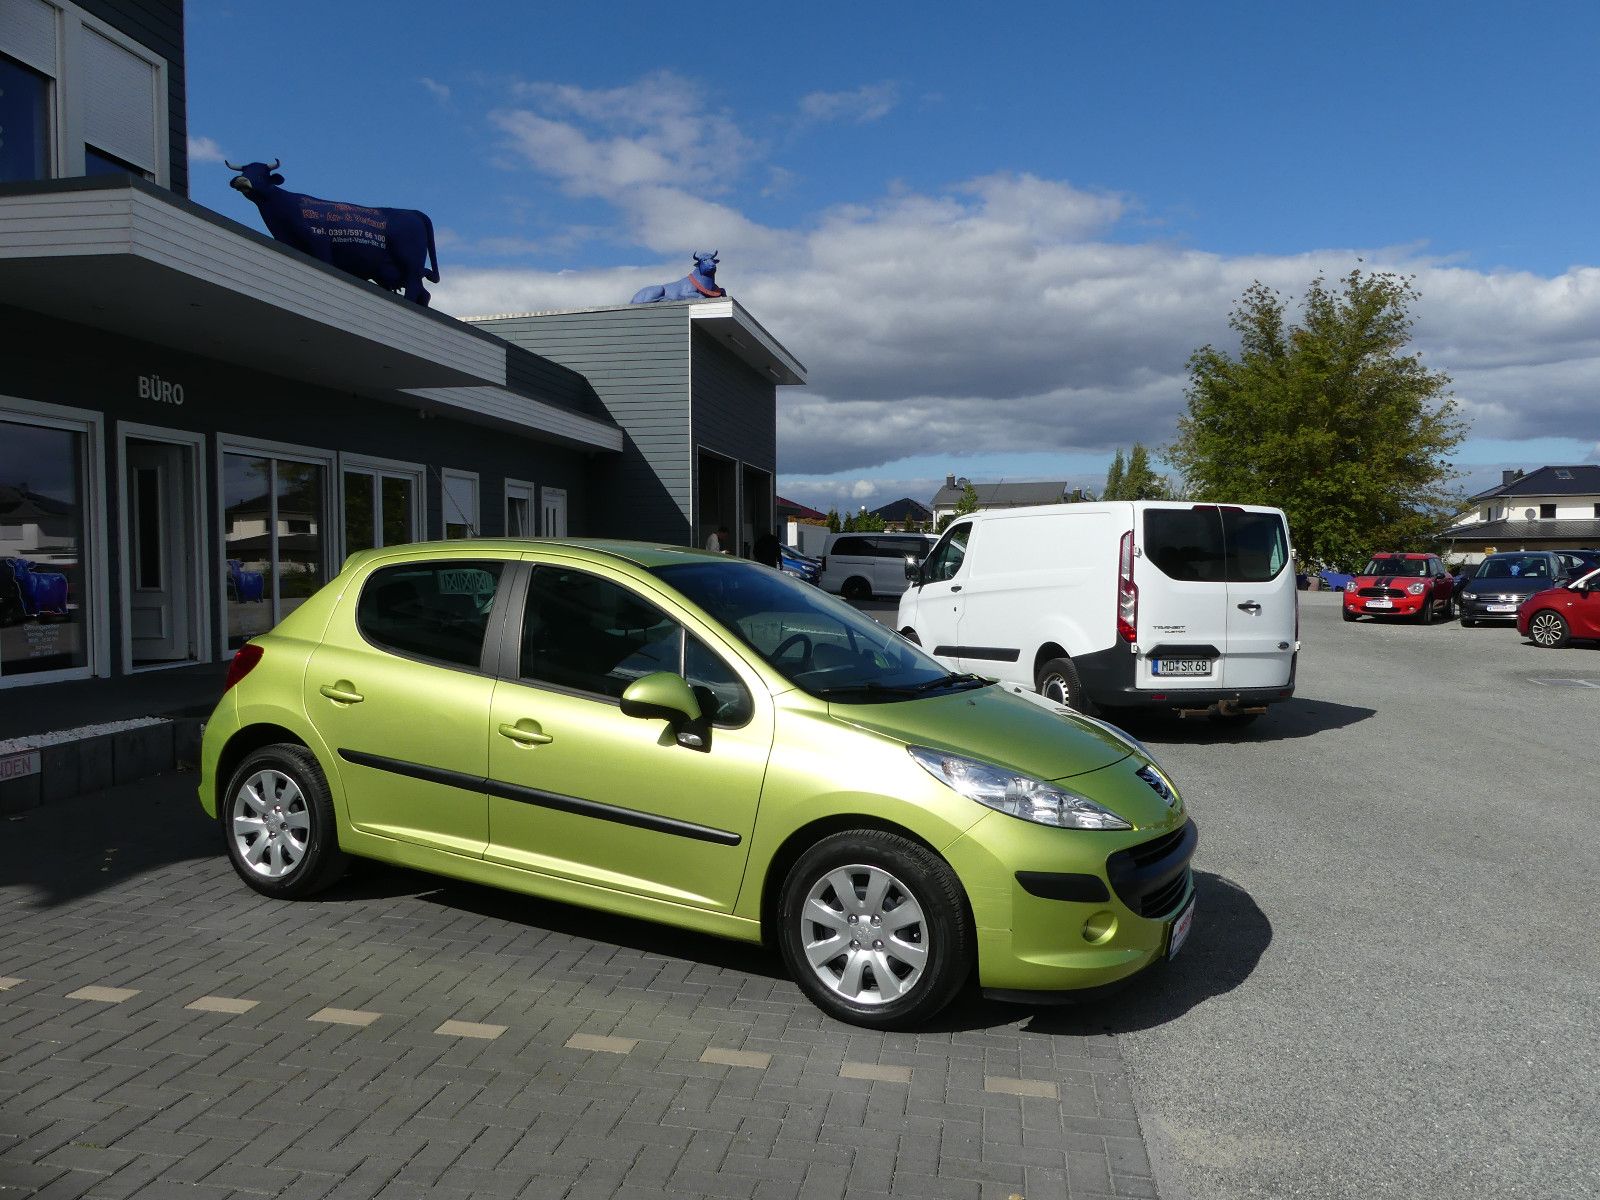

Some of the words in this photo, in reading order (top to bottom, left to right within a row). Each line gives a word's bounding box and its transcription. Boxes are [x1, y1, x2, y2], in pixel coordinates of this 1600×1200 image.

[310, 226, 326, 236] Tel.
[374, 234, 386, 243] 100
[138, 374, 185, 406] BÜRO
[1161, 660, 1175, 672] MD
[1181, 660, 1193, 672] SR
[1195, 660, 1207, 672] 68
